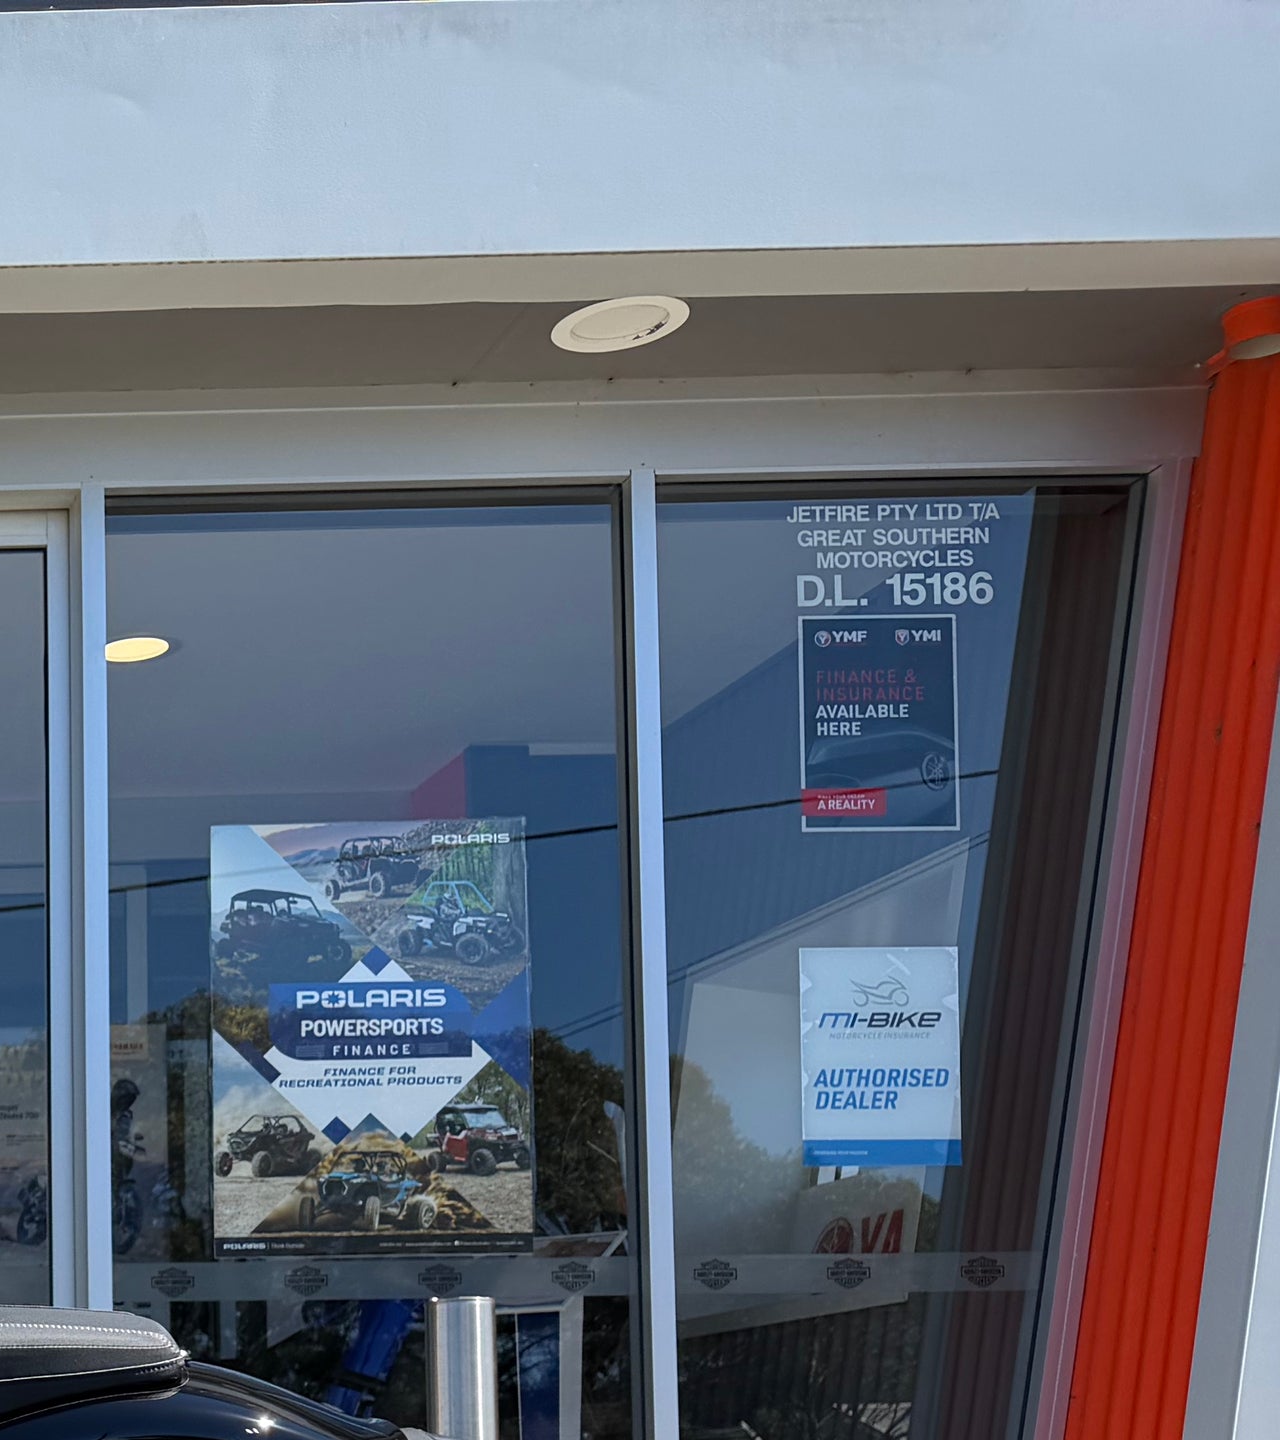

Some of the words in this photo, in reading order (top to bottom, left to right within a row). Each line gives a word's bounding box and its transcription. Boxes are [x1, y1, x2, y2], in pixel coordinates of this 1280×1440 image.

[786, 505, 870, 523] JETFIRE
[877, 504, 919, 521] PTY
[925, 503, 963, 521] LTD
[968, 502, 1000, 522] T/A
[797, 529, 867, 547] GREAT
[872, 527, 990, 546] SOUTHERN
[816, 549, 974, 569] MOTORCYCLES
[796, 574, 869, 607] D.L.
[885, 571, 994, 606] 15186
[832, 630, 868, 643] YMF
[911, 629, 942, 642] YMI
[816, 669, 897, 684] FINANCE
[904, 668, 918, 683] &
[816, 686, 925, 702] INSURANCE
[815, 703, 909, 719] AVAILABLE
[816, 721, 862, 736] HERE
[817, 799, 827, 810] A
[828, 799, 876, 810] REALITY
[431, 833, 511, 845] POLARIS
[296, 988, 448, 1009] POLARIS
[300, 1018, 444, 1038] POWERSPORTS
[333, 1044, 412, 1057] FINANCE
[324, 1067, 385, 1077] FINANCE
[389, 1066, 417, 1076] FOR
[813, 1067, 950, 1088] AUTHORISED
[278, 1078, 383, 1089] RECREATIONAL
[387, 1075, 463, 1087] PRODUCTS
[815, 1090, 899, 1110] DEALER
